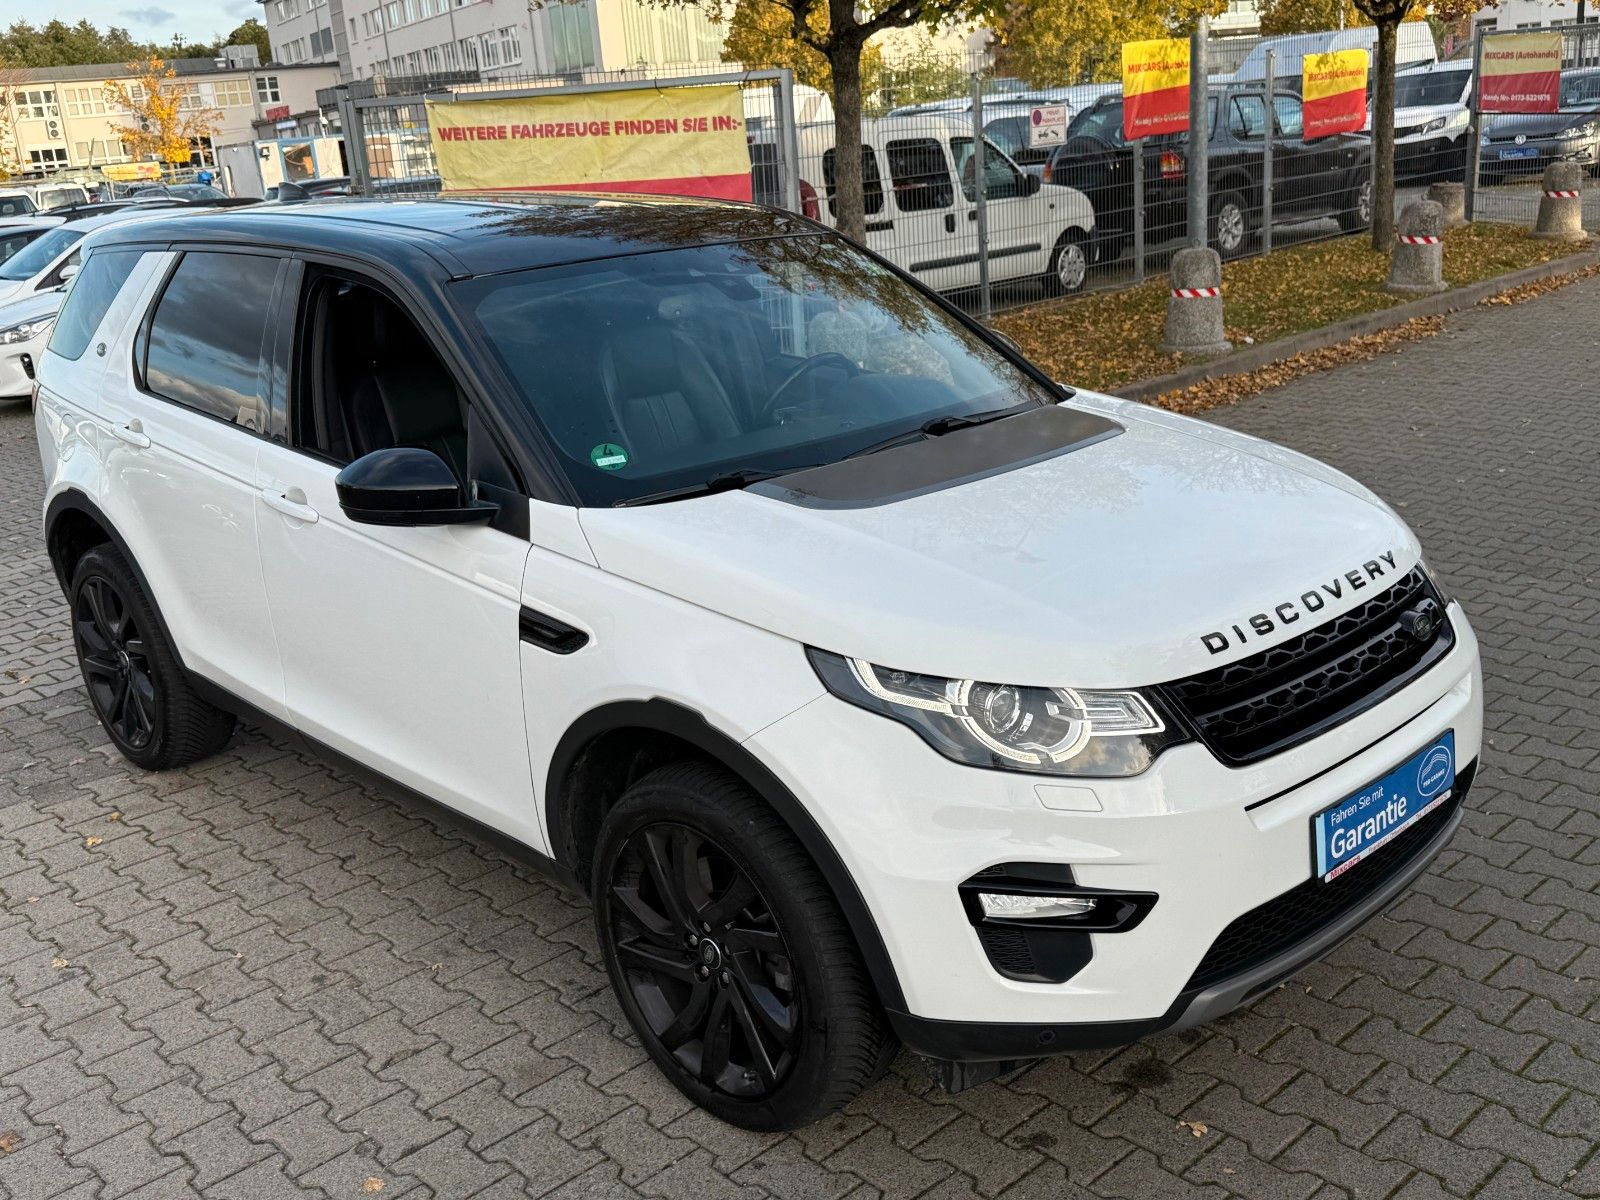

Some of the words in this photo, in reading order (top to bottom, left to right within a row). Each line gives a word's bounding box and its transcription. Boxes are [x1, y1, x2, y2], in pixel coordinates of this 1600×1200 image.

[1128, 61, 1162, 74] MIXCARS
[1516, 50, 1559, 61] (Autohandel)
[437, 125, 508, 142] WEITERE
[511, 121, 610, 140] FAHRZEUGE
[614, 118, 678, 136] FINDEN
[682, 117, 708, 133] SIE
[603, 444, 614, 457] 4
[1200, 550, 1396, 655] DISCOVERY
[1331, 804, 1358, 828] Fahren
[1358, 795, 1371, 810] Sie
[1372, 786, 1384, 802] mit
[1331, 794, 1407, 859] Garantie
[1330, 855, 1361, 880] Mixcars
